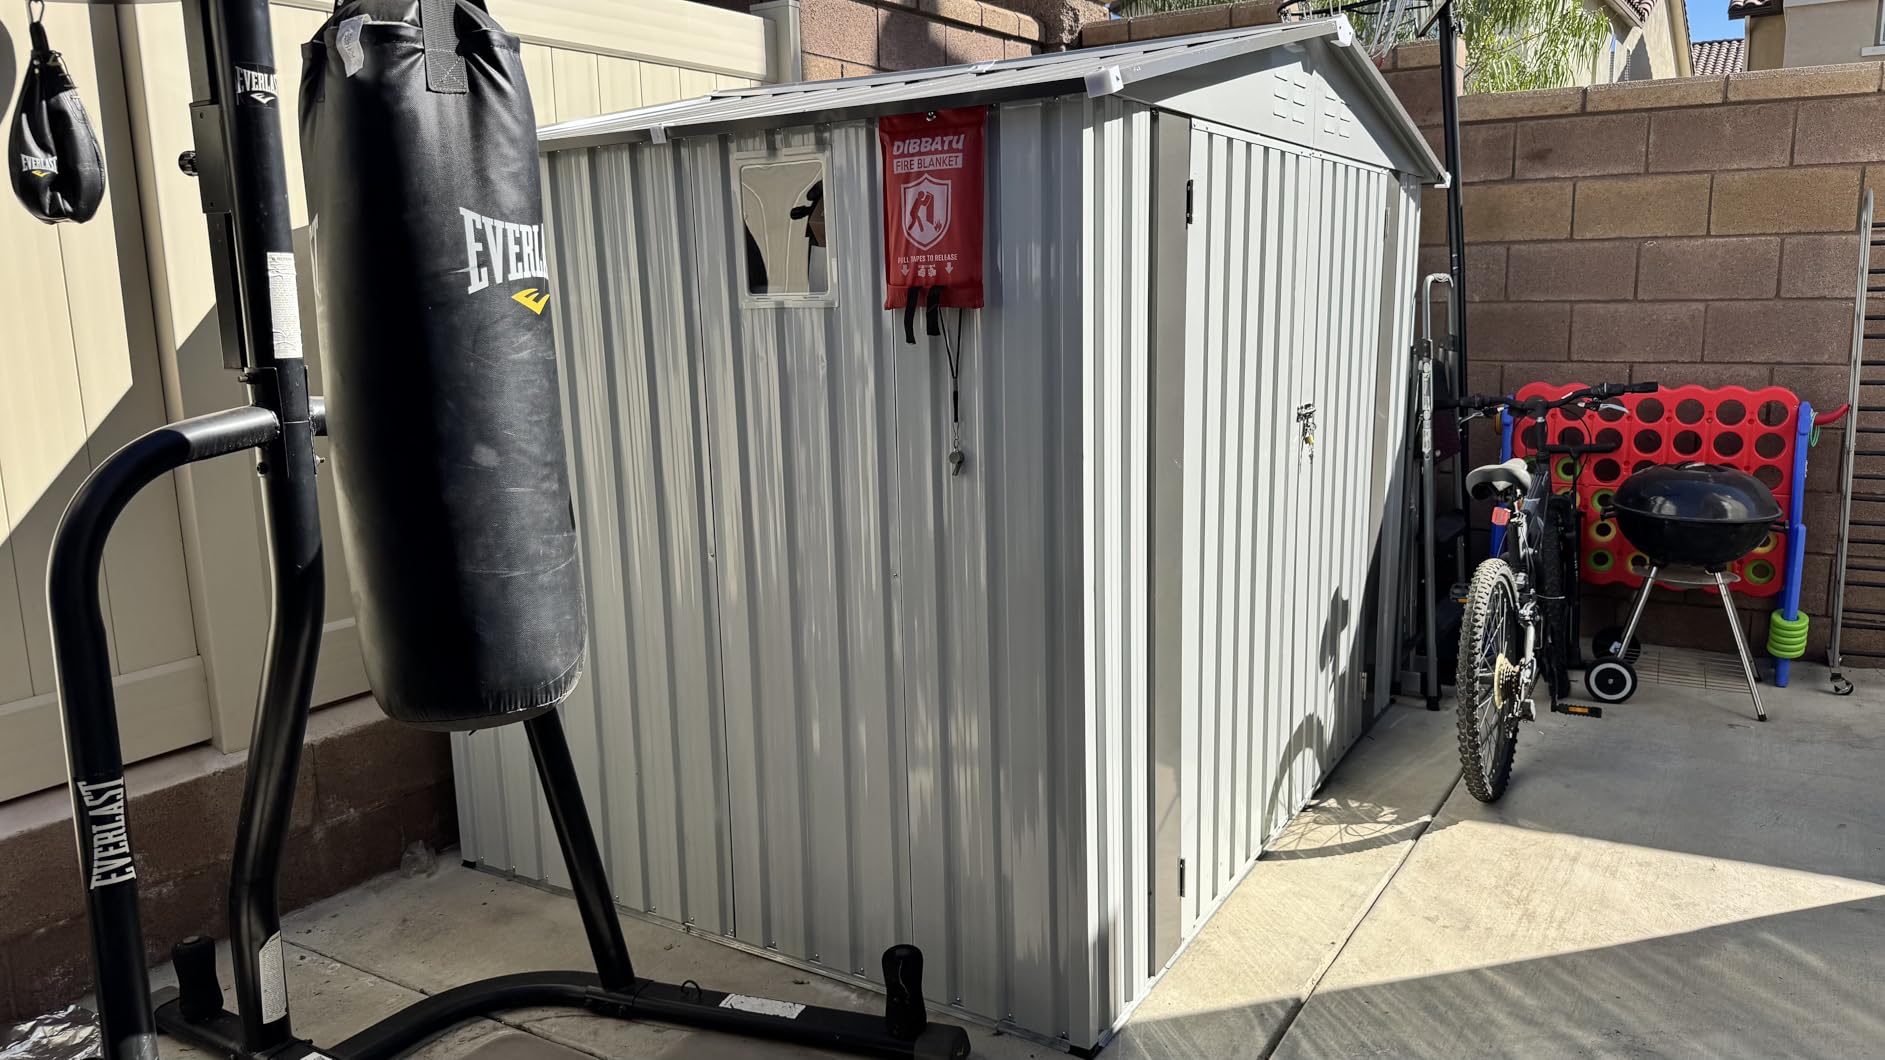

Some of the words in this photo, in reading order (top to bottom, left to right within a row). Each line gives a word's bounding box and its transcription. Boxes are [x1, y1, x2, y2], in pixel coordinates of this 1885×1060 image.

[893, 134, 965, 155] DIBBATU
[20, 153, 58, 174] EVERLAST
[896, 159, 915, 172] FIRE
[917, 155, 960, 169] BLANKET
[910, 255, 926, 263] TAPES
[927, 254, 934, 262] TO
[934, 253, 958, 262] RELEASE
[77, 776, 136, 890] EVERLAST
